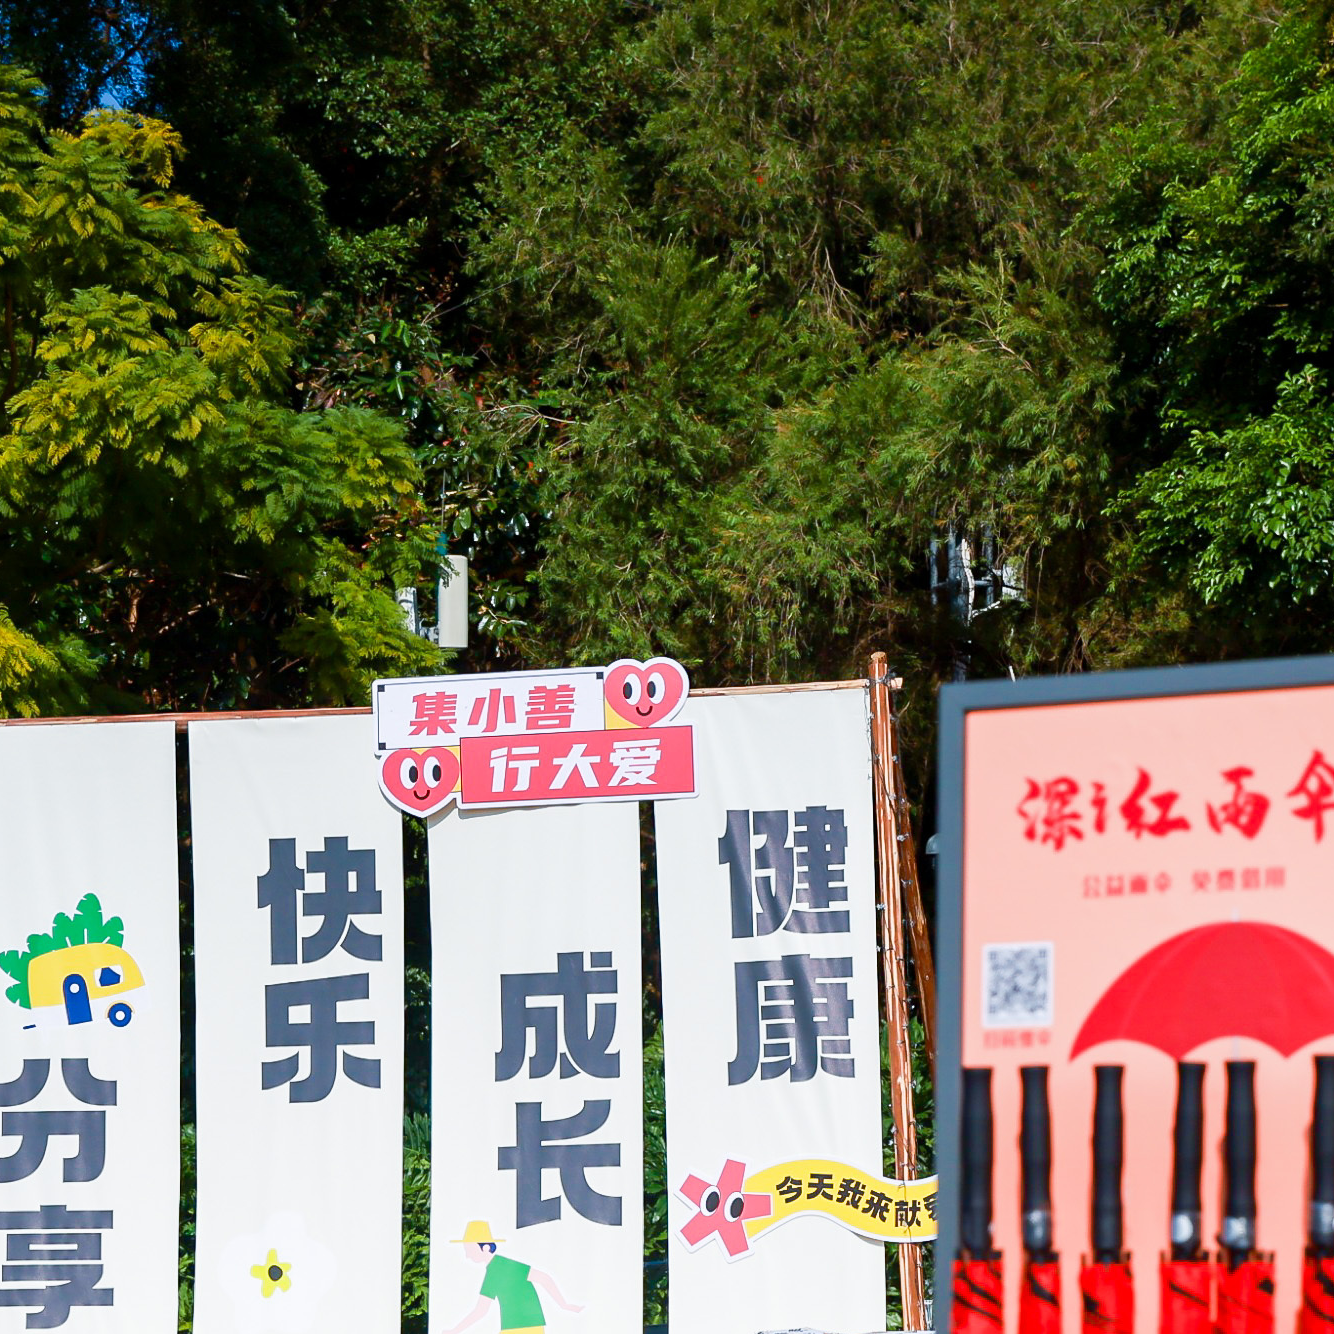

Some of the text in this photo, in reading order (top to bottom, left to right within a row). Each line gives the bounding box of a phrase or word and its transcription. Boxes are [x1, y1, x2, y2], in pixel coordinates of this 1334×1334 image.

[409, 684, 576, 736] 集小善
[490, 738, 661, 793] 行大爱
[257, 836, 383, 1103] 快乐
[717, 806, 855, 1086] 健康
[495, 951, 623, 1228] 成长
